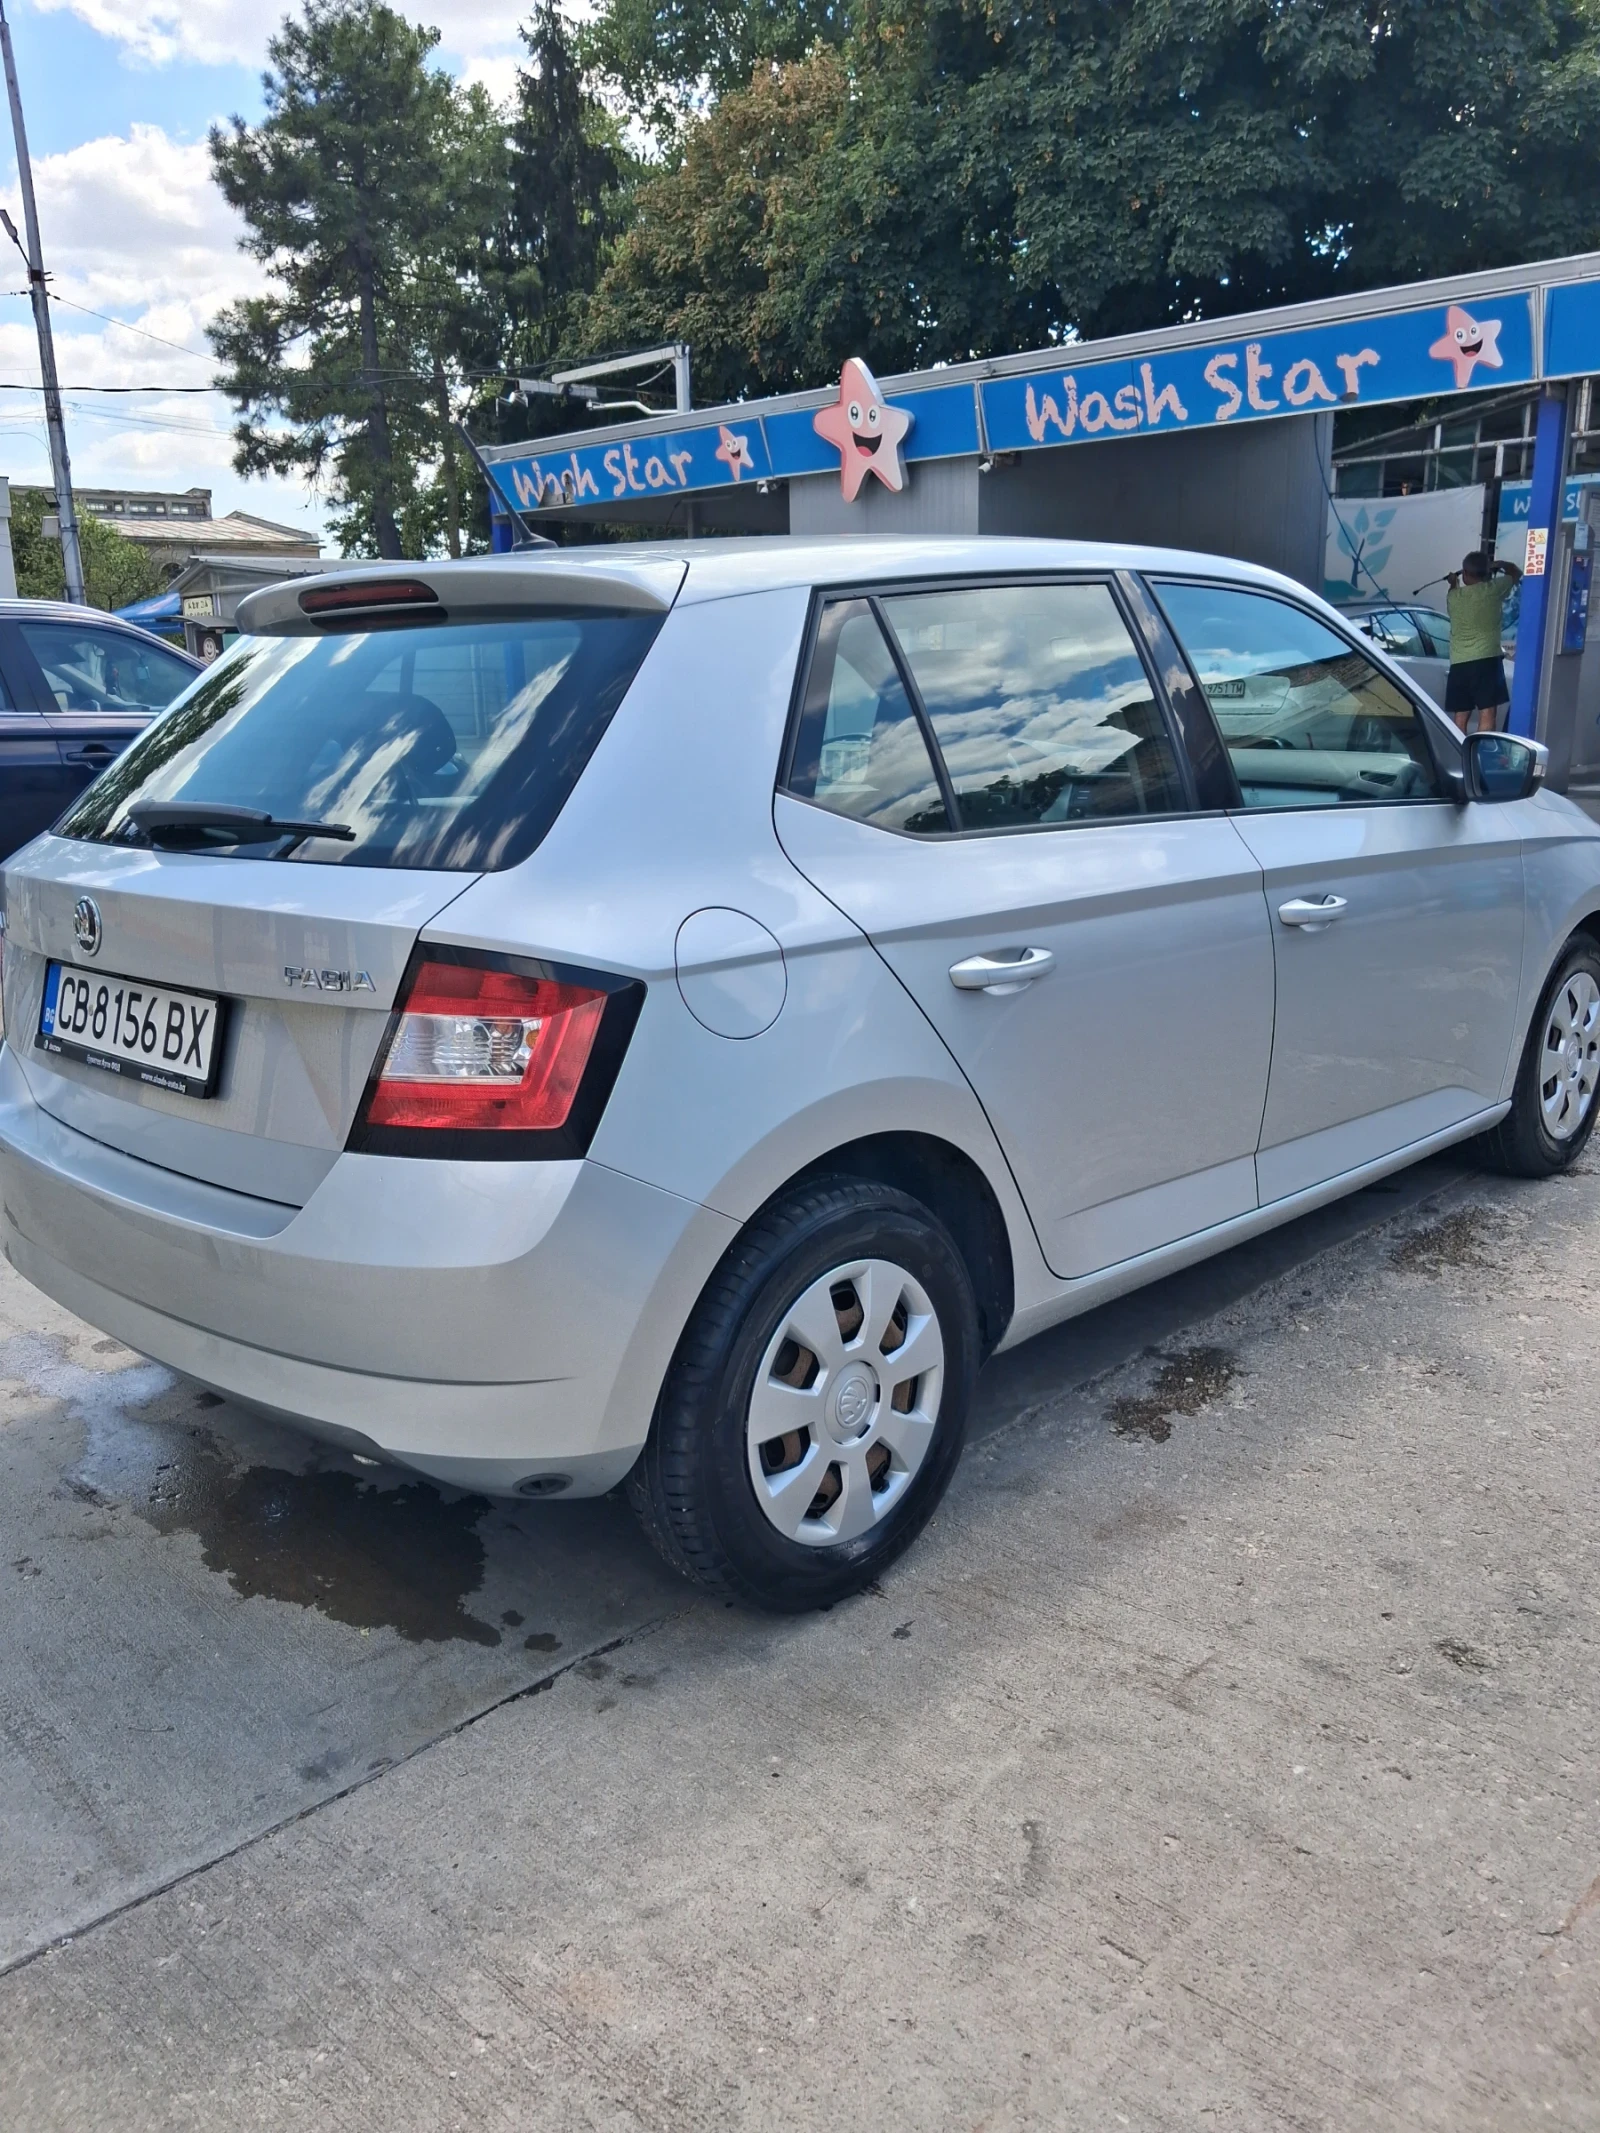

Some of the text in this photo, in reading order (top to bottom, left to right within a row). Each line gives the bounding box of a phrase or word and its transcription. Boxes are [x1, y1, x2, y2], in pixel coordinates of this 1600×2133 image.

[1026, 345, 1381, 442] Wash Star
[603, 444, 692, 497] Star
[1536, 554, 1544, 574] ПОД
[1207, 683, 1229, 694] 9751
[284, 965, 377, 992] FABIA
[44, 1007, 56, 1024] BG
